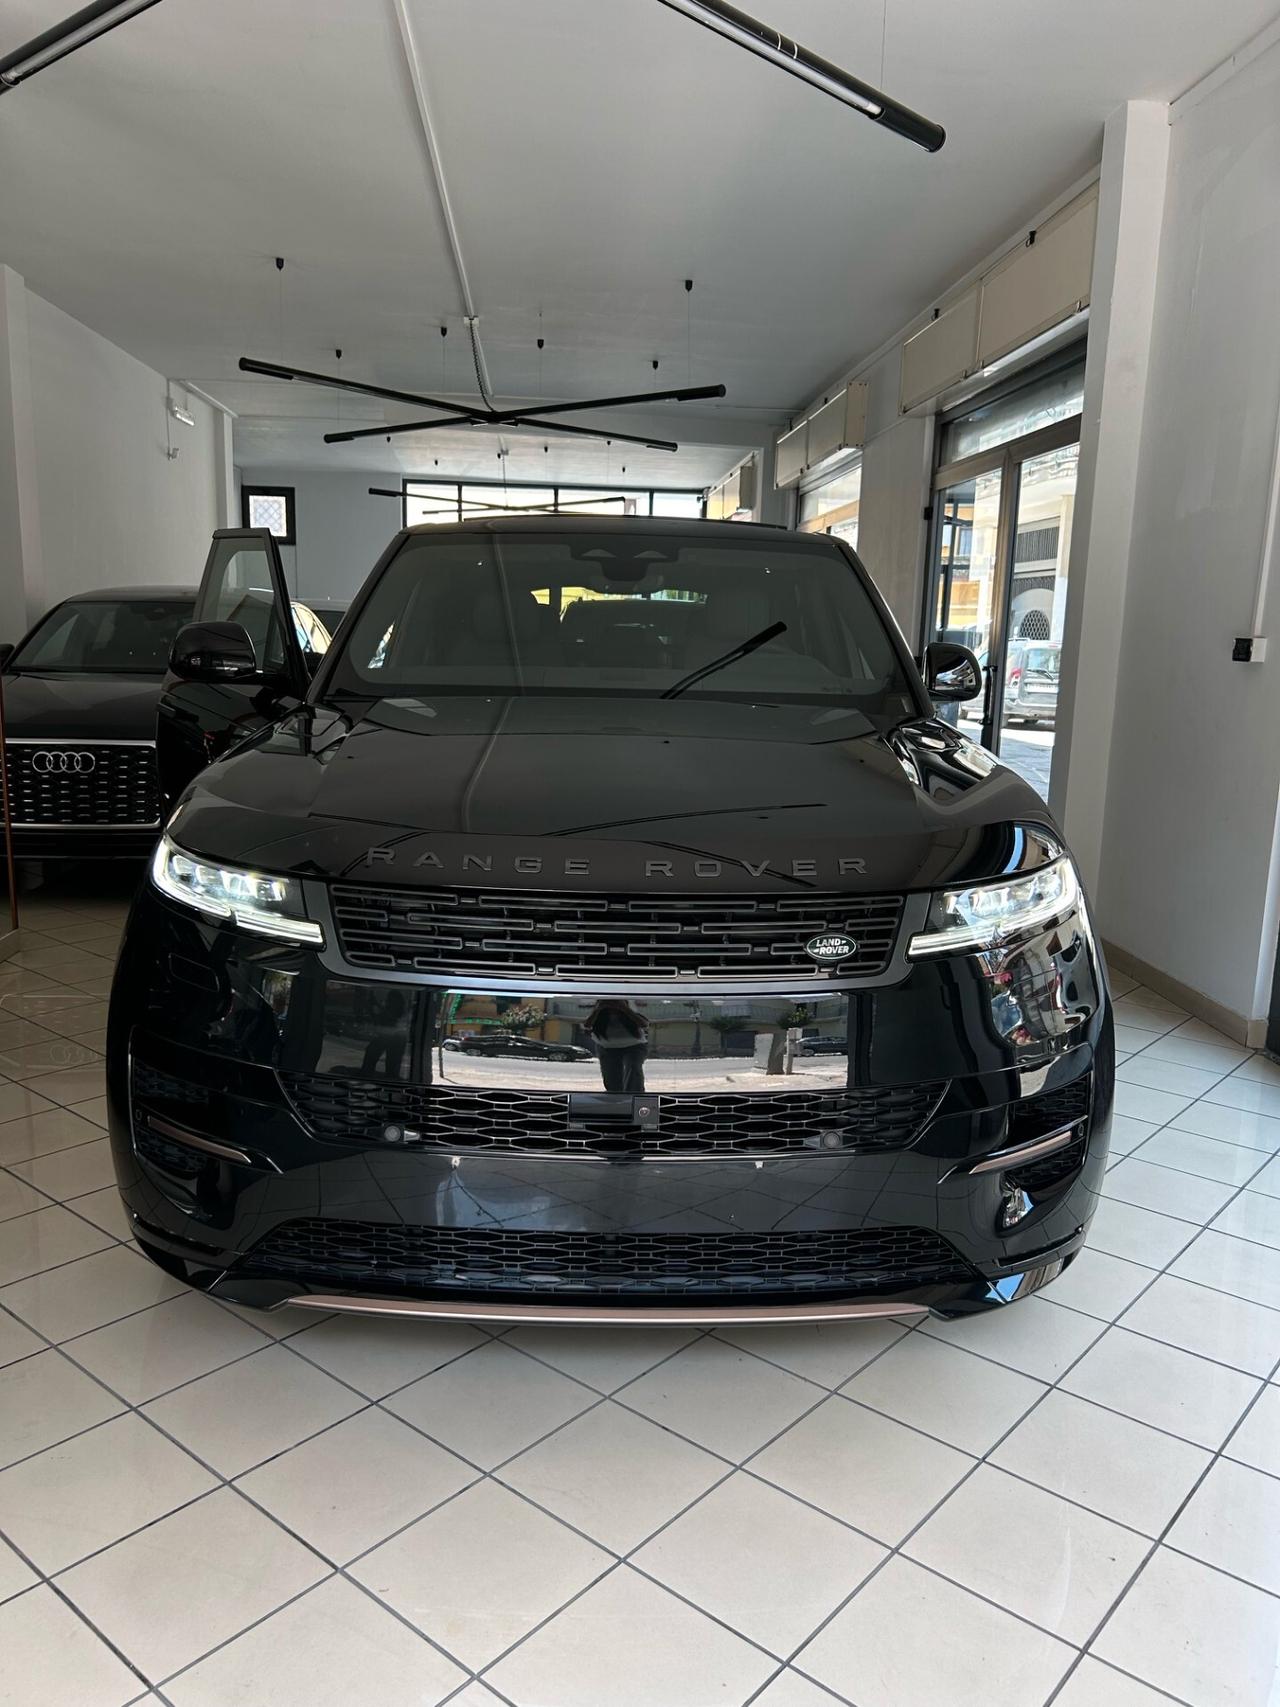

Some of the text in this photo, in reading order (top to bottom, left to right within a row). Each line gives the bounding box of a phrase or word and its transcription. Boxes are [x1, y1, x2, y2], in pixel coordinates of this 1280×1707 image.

[365, 847, 868, 877] RANGE ROVER
[816, 938, 841, 947] LAND
[819, 945, 850, 955] ROVER
